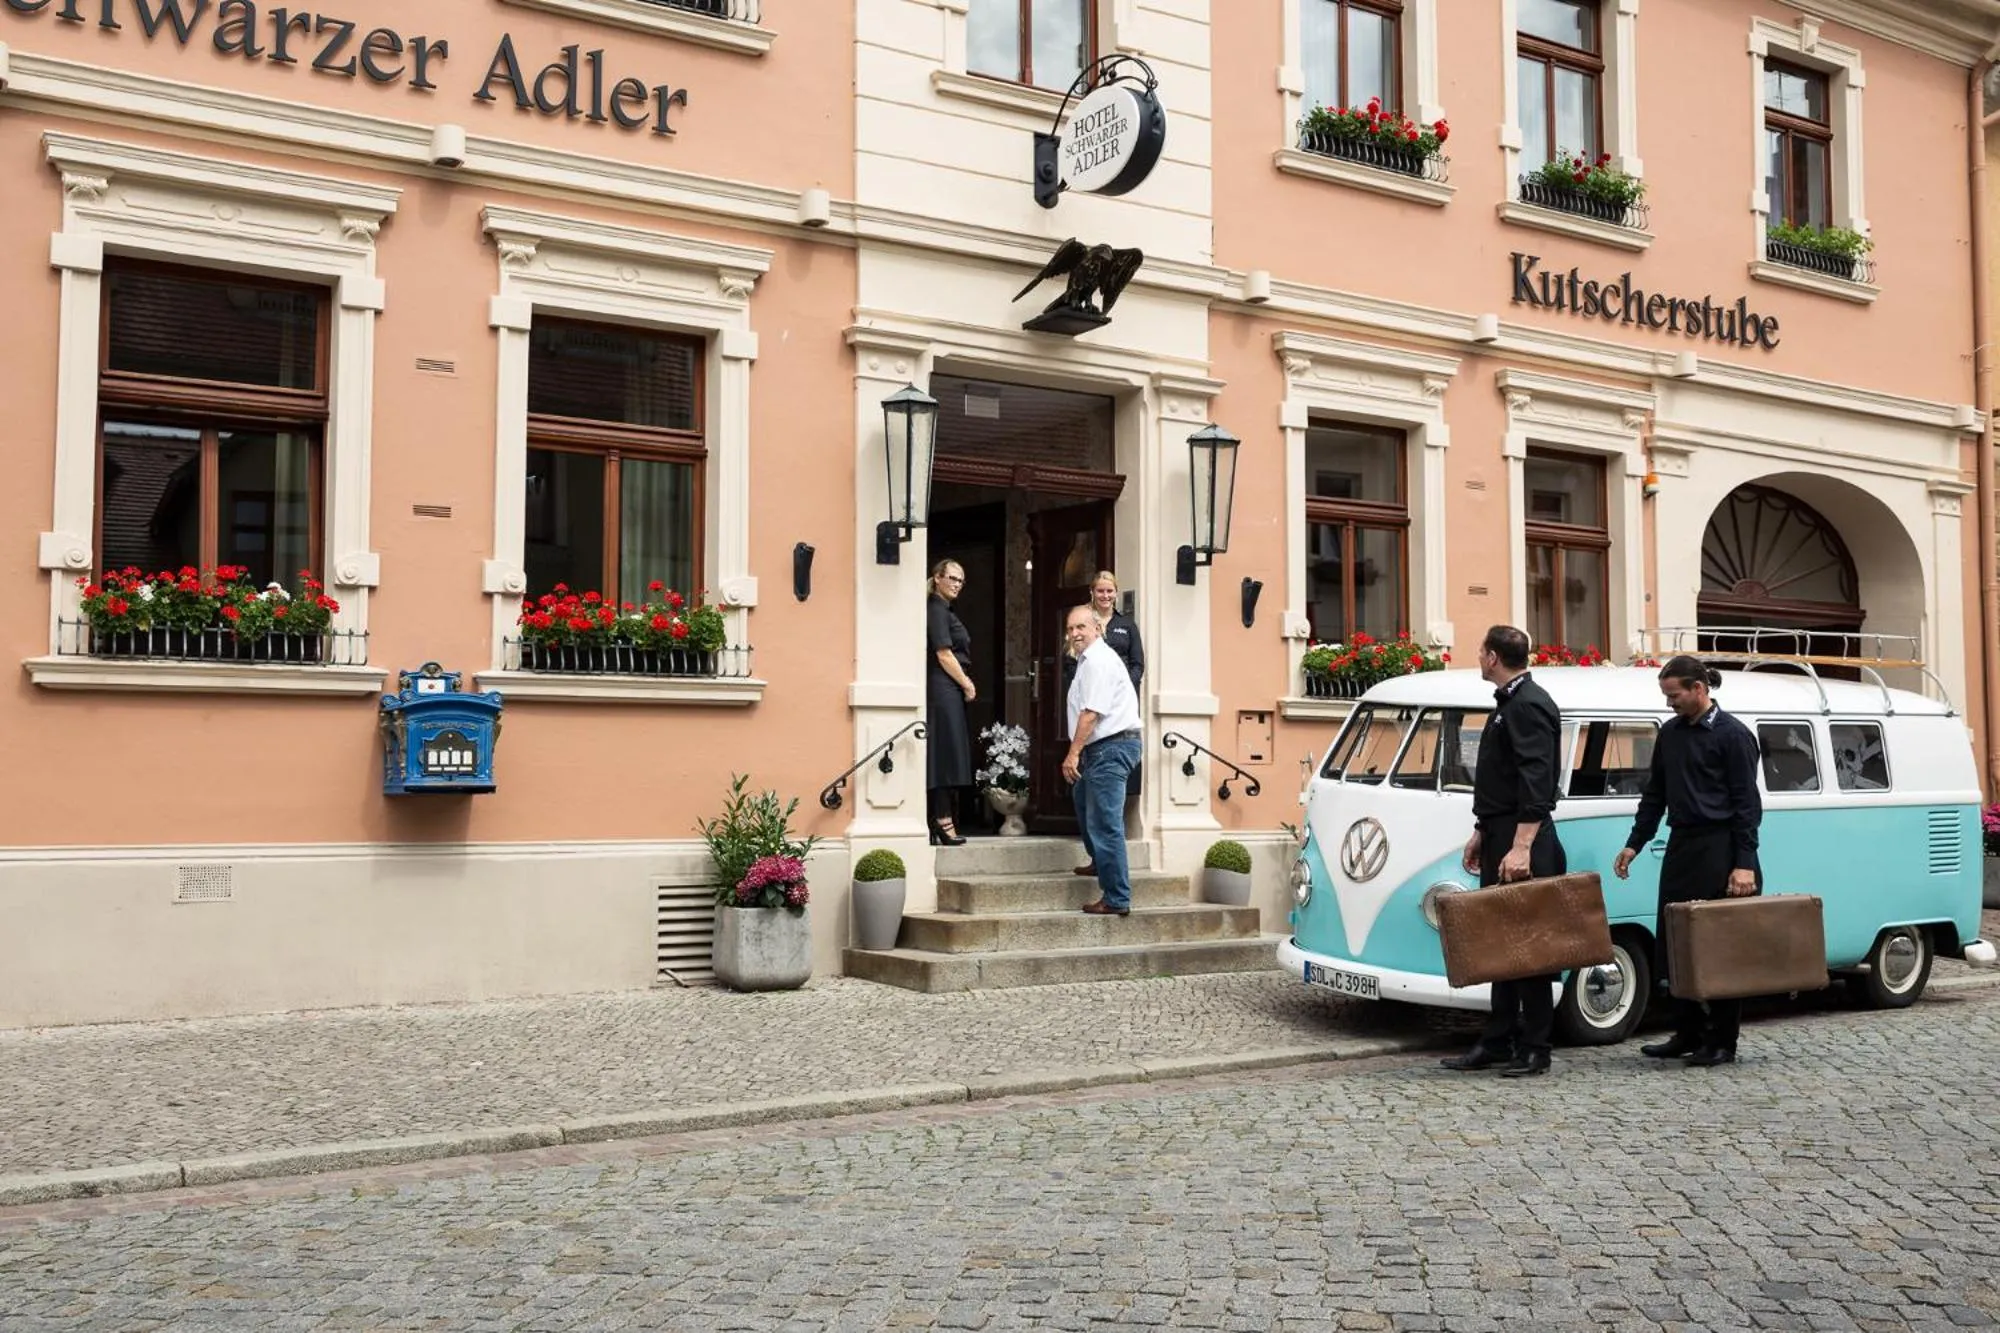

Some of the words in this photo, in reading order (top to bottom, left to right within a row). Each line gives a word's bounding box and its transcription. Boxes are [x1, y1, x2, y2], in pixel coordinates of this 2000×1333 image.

[4, 0, 449, 90] warzer
[472, 32, 689, 135] Adler
[1065, 118, 1128, 158] SCHWARZER
[1074, 103, 1119, 138] HOTEL
[1073, 138, 1121, 176] ADLER
[1511, 251, 1781, 350] Kutscherstube
[1341, 817, 1389, 883] VW
